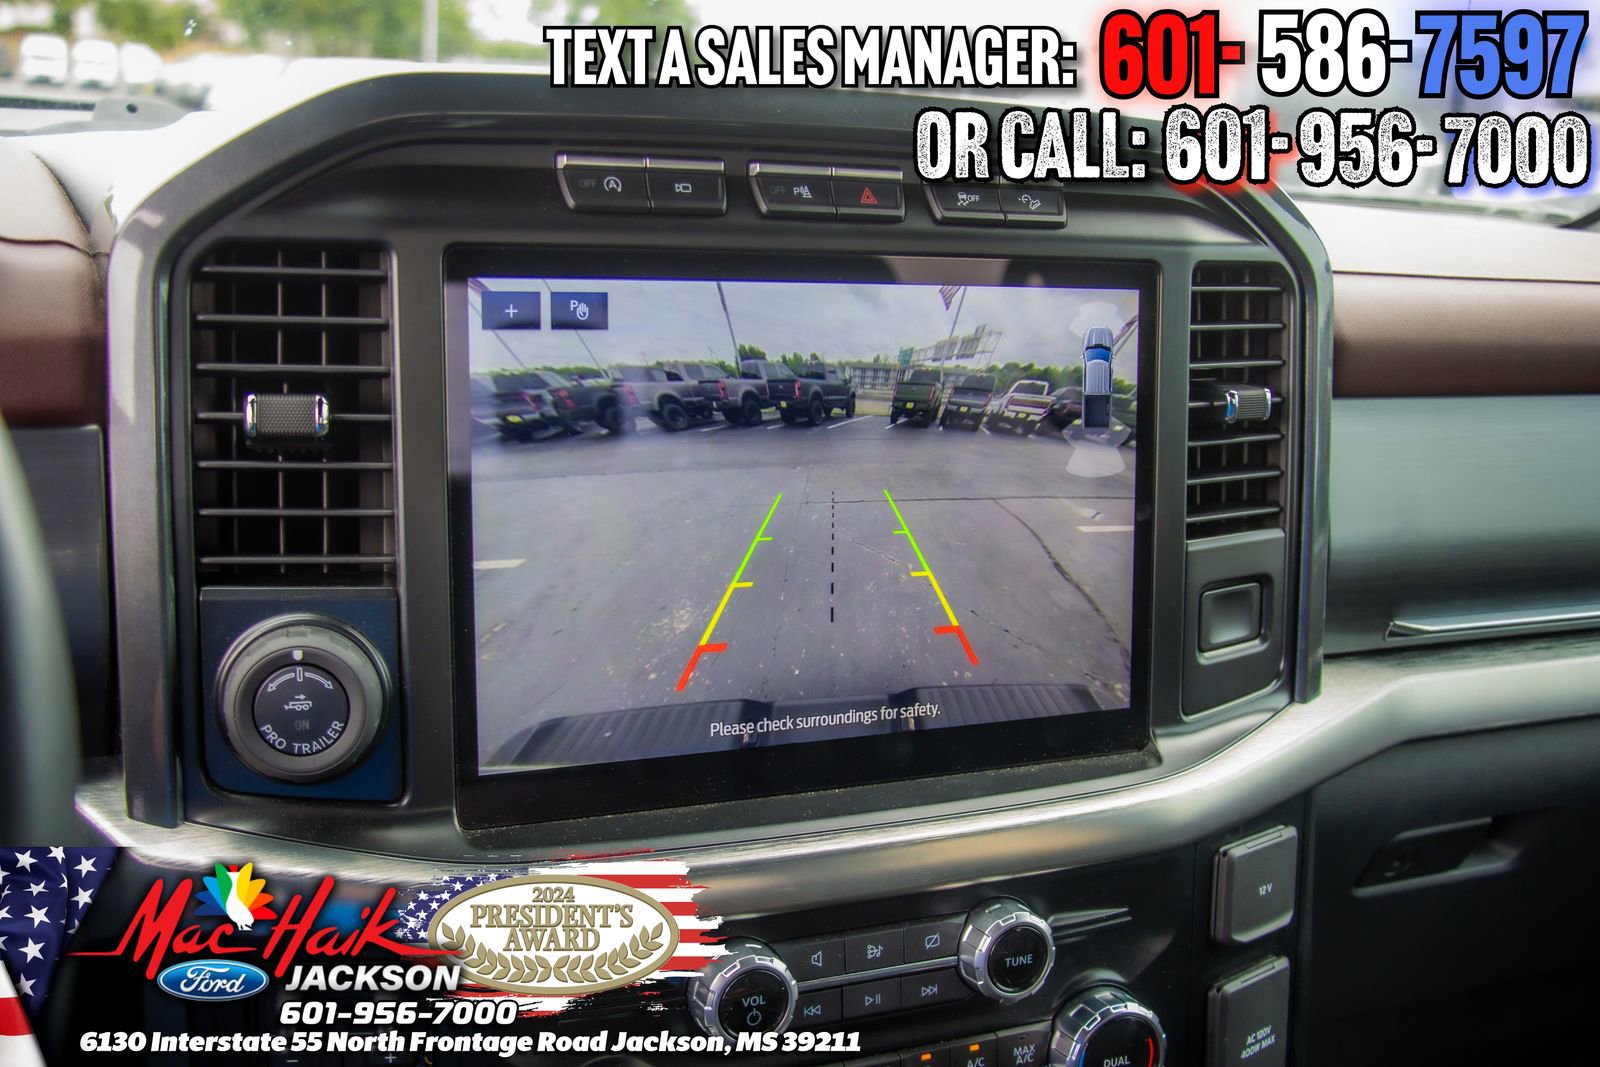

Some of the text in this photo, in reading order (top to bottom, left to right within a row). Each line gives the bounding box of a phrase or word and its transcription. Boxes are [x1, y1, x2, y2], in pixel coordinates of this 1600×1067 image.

[578, 179, 597, 188] OFF
[967, 194, 980, 202] OFF
[295, 720, 310, 730] ON
[710, 702, 941, 736] Please check surroundings for safety.
[260, 720, 344, 755] PRO TRAILER
[1005, 953, 1033, 968] TUNE
[741, 995, 766, 1007] VOL
[1013, 1044, 1035, 1056] MAX
[967, 1057, 985, 1067] A/C
[1016, 1053, 1034, 1065] A/C
[1103, 1055, 1130, 1067] DUAL
